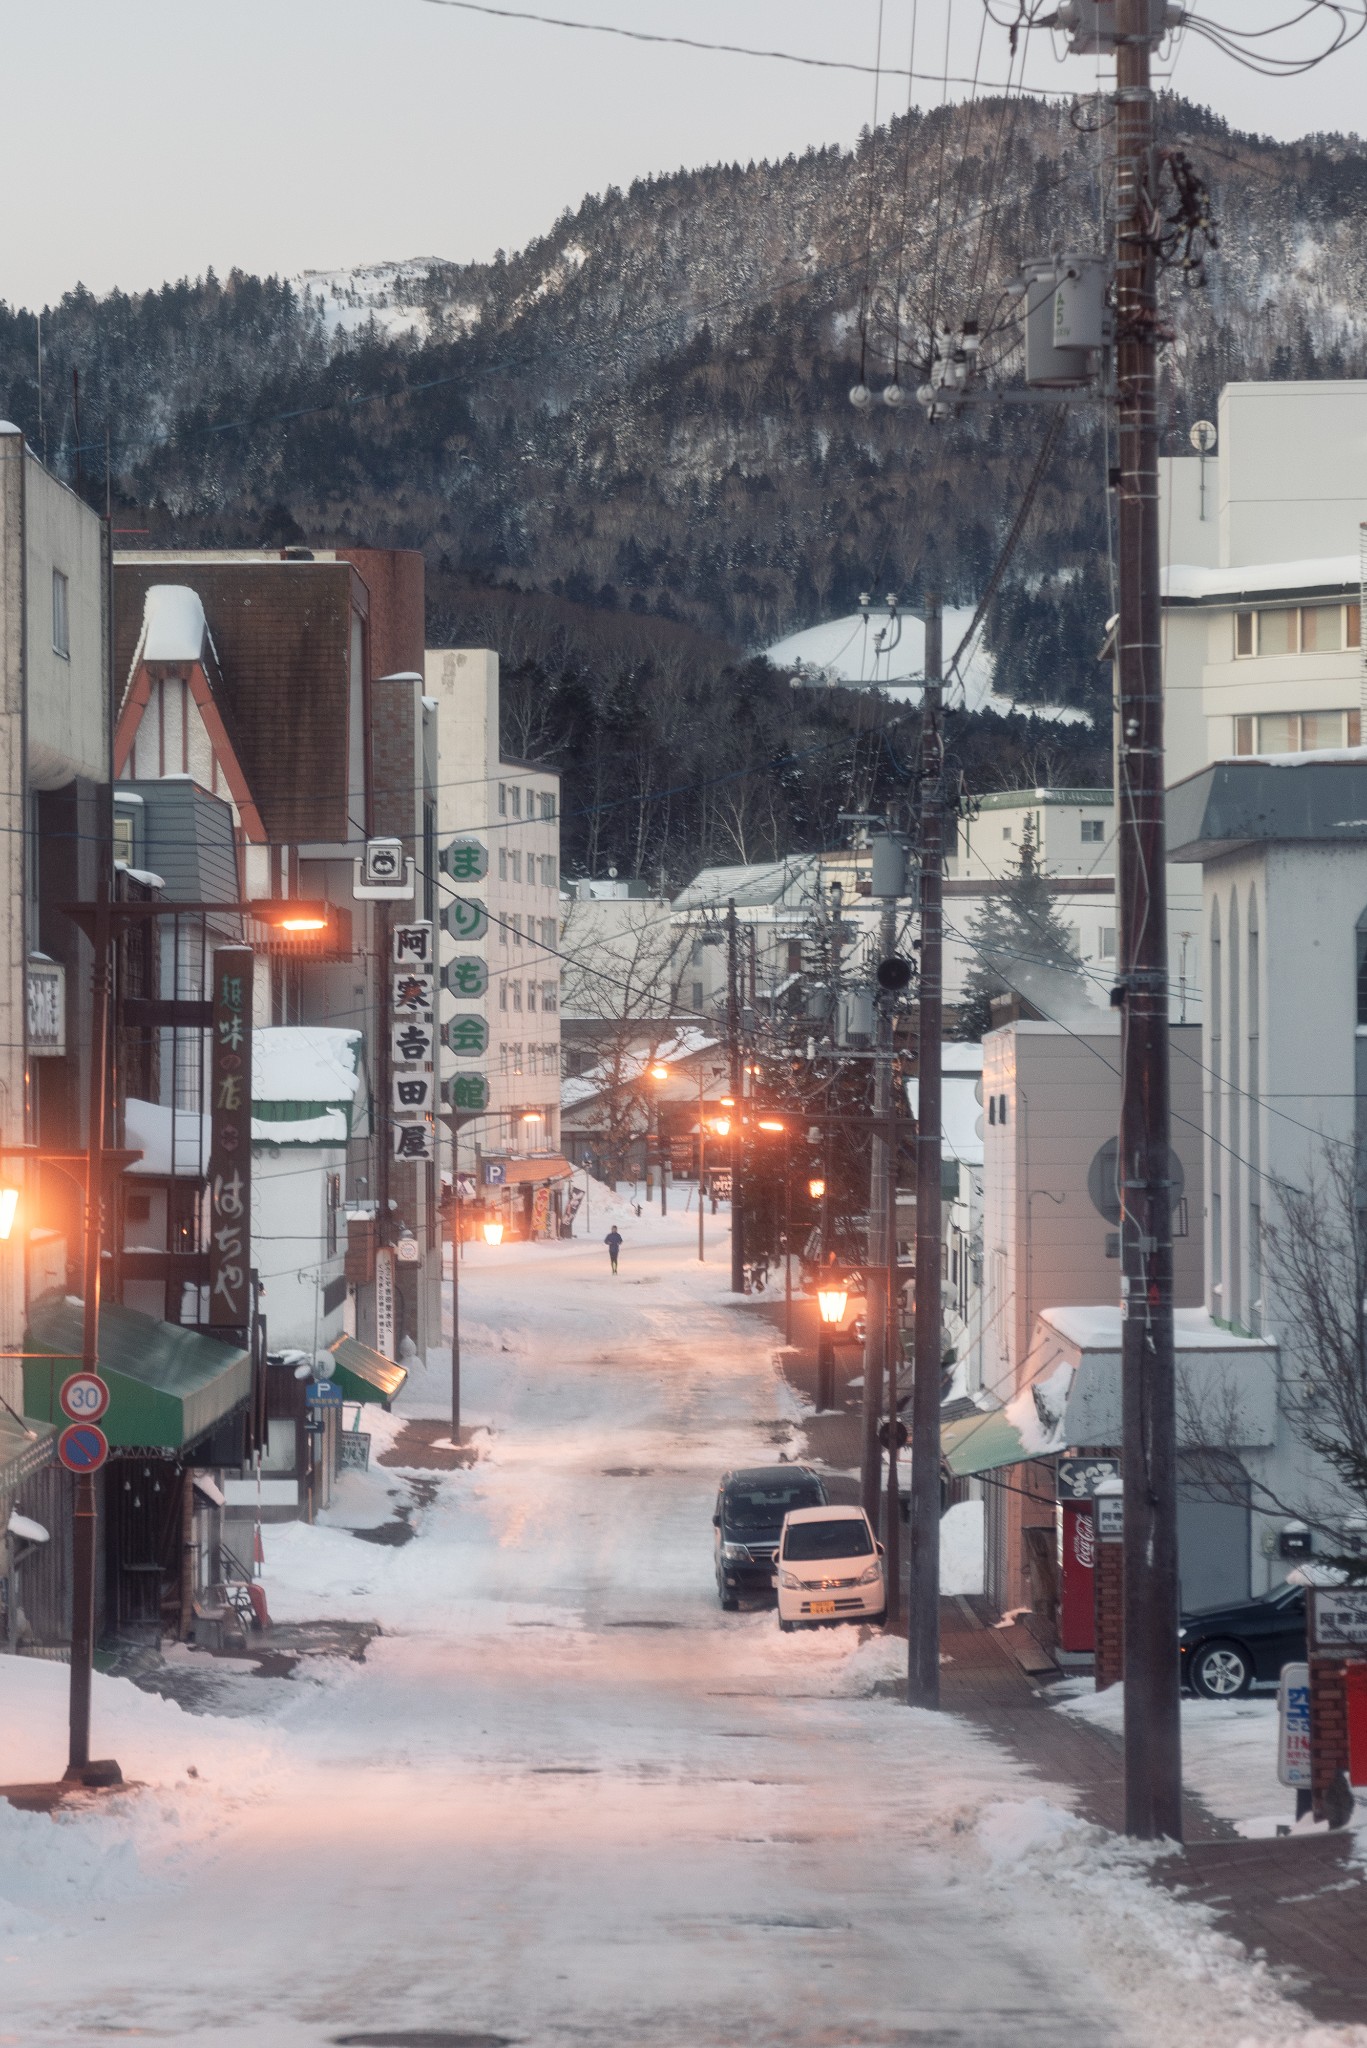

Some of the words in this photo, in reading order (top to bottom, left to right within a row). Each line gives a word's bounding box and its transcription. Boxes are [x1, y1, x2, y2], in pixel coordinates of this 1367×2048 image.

[218, 974, 244, 1112] 趣味の店
[396, 928, 430, 1158] 阿寒吉田屋
[452, 847, 486, 1110] まりも会館
[214, 1168, 245, 1314] はちや
[489, 1166, 502, 1183] P
[72, 1387, 99, 1409] 30
[317, 1383, 331, 1397] P
